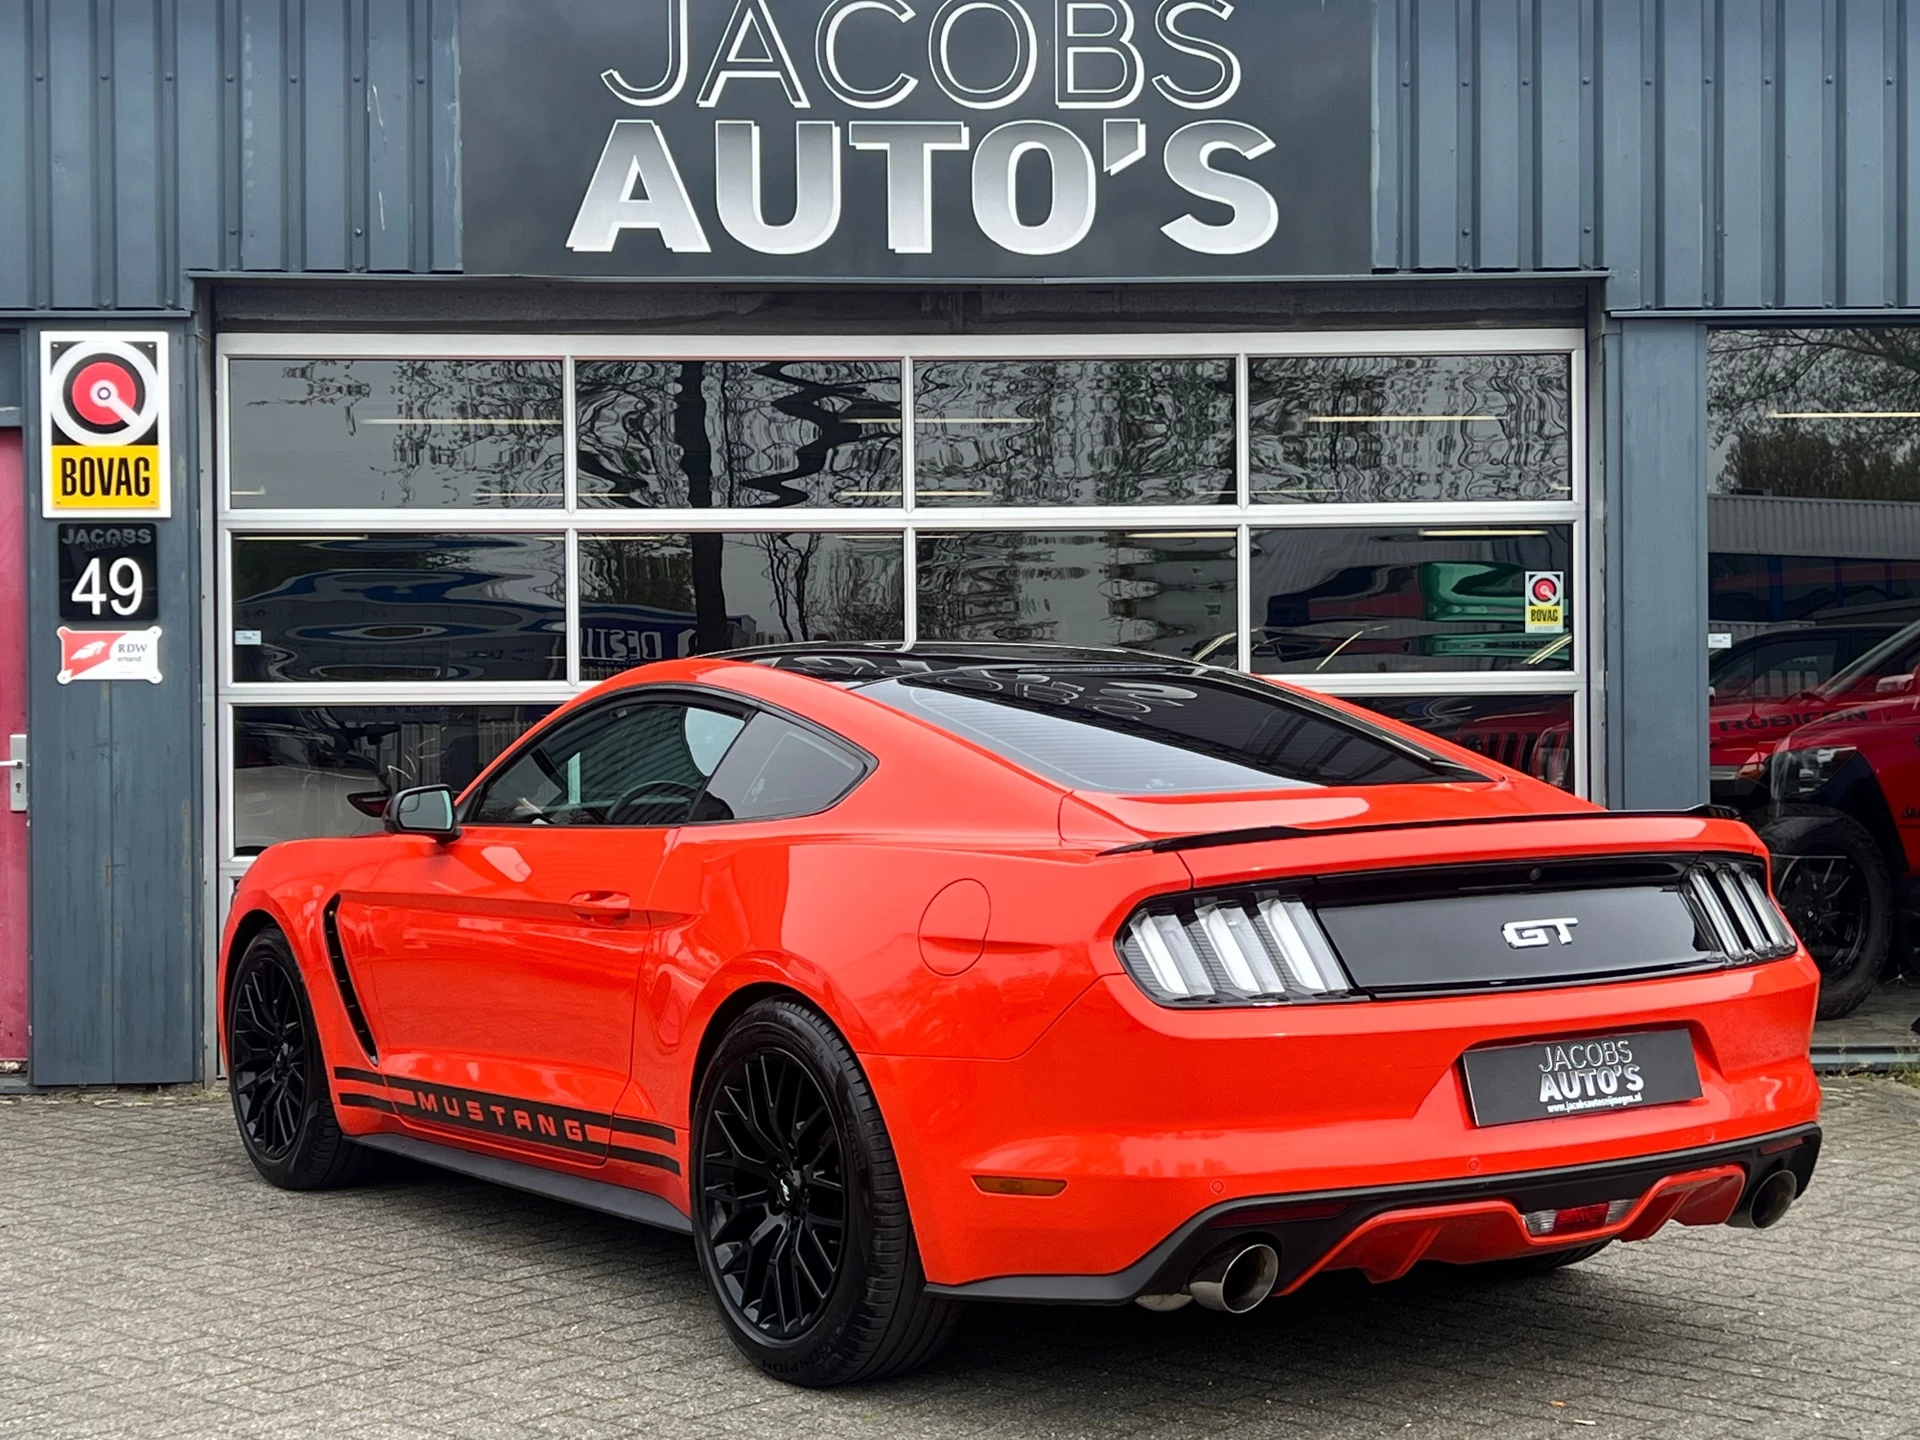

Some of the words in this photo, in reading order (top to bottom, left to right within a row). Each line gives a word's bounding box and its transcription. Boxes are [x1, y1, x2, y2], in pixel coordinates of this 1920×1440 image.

[600, 0, 1243, 110] JACOBS
[564, 118, 1280, 255] AUTO'S
[61, 456, 150, 497] BOVAG
[61, 528, 152, 544] JACOBS
[71, 556, 143, 617] 49
[1530, 608, 1559, 622] BOVAG
[117, 643, 148, 653] RDW
[1502, 916, 1579, 949] GT
[1539, 1040, 1633, 1072] JACOBS
[1539, 1064, 1645, 1102] AUTO'S
[415, 1092, 586, 1142] MUSTANG
